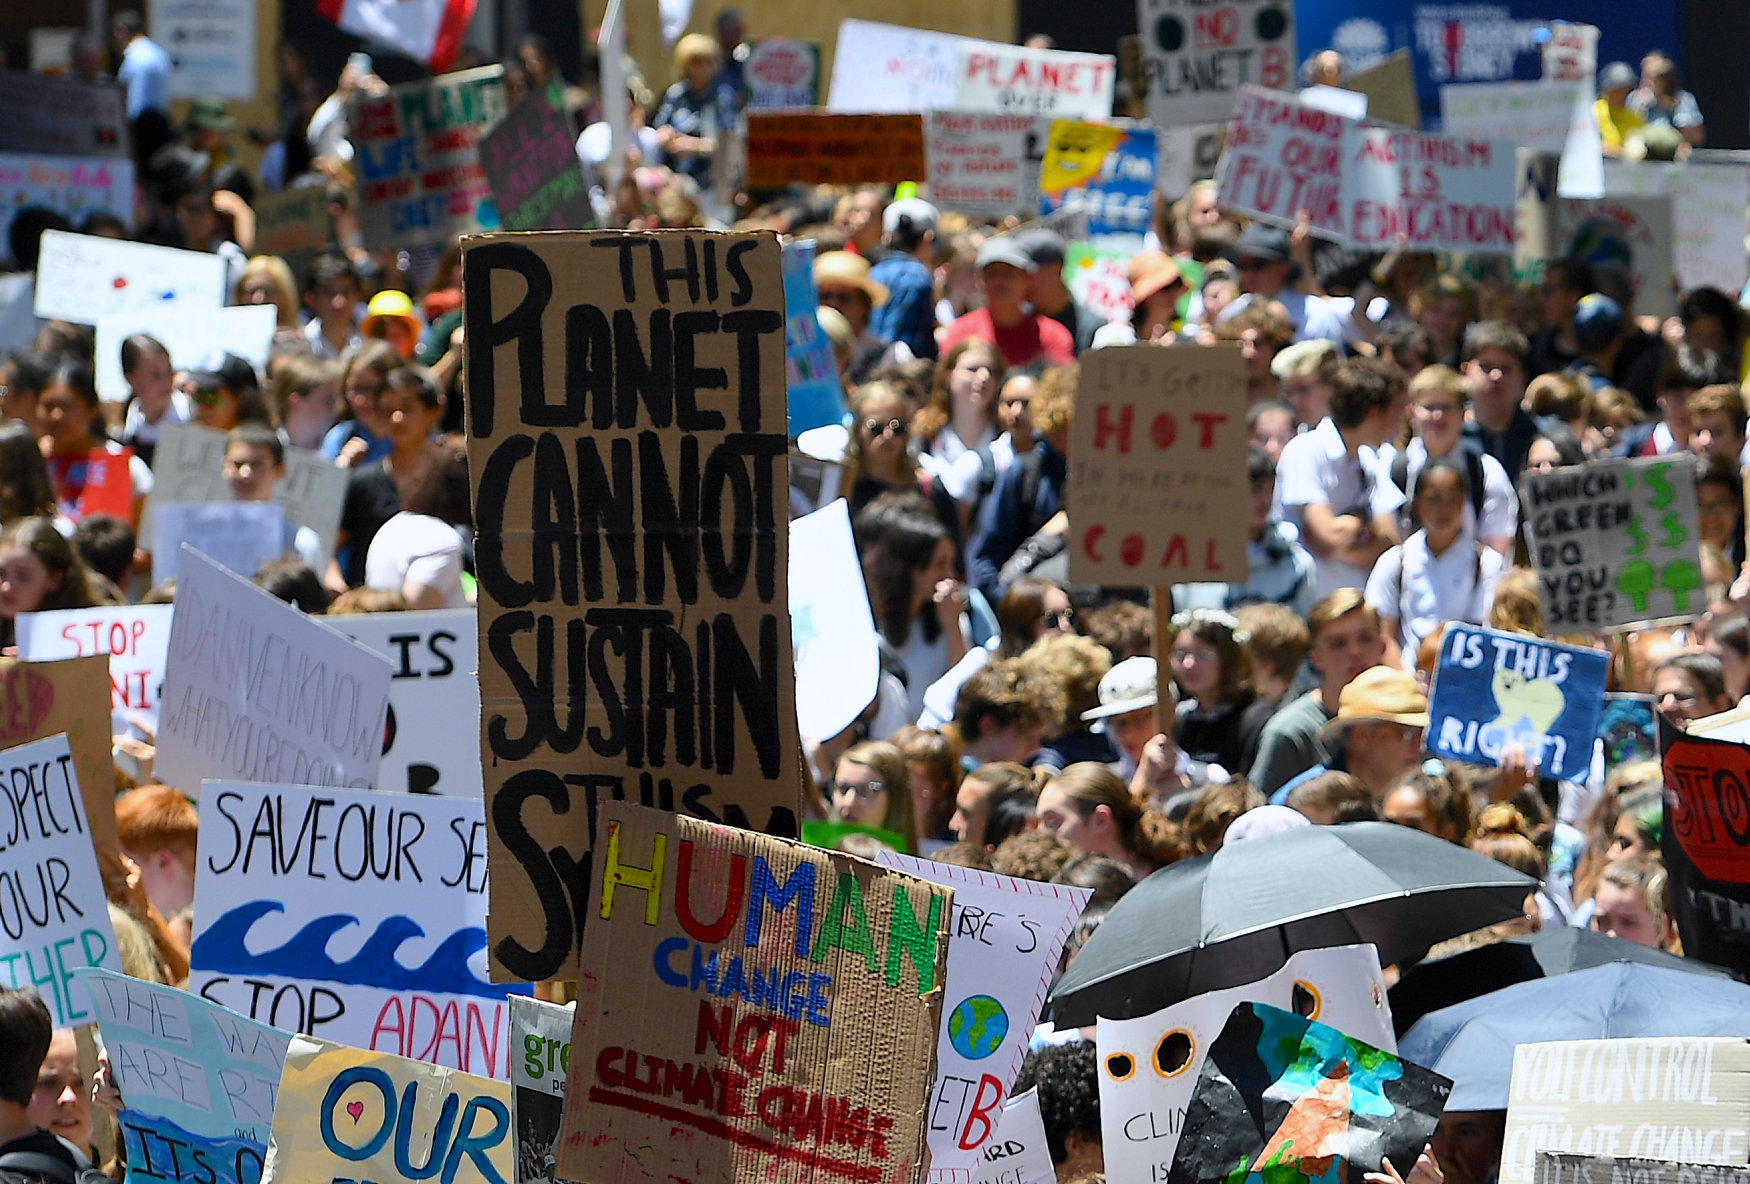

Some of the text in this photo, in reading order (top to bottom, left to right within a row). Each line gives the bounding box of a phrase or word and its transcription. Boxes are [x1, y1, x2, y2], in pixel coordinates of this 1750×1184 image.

[966, 55, 1114, 95] PLANET
[591, 237, 758, 306] THIS
[464, 242, 782, 438] PLANET
[1093, 403, 1229, 455] HOT
[1531, 471, 1618, 503] WHICH
[477, 429, 790, 607] CANNOT
[1083, 523, 1223, 573] COAL
[1534, 503, 1633, 538] GREEN
[1539, 541, 1582, 569] DO
[1543, 568, 1607, 598] YOU
[62, 619, 147, 658] STOP
[1550, 592, 1615, 626] SEE?
[1450, 630, 1573, 685] IS THIS
[489, 607, 781, 781] SUSTAIN
[208, 790, 338, 880] SAVE
[334, 802, 426, 884] OUR
[599, 819, 943, 999] HUMAN
[99, 976, 189, 1043] THE
[200, 976, 346, 1037] STOP
[653, 937, 833, 1028] CHANGE
[694, 1002, 799, 1074] NOT
[119, 1045, 211, 1113] ARE
[596, 1046, 748, 1119] CLIMATE
[756, 1084, 895, 1160] CHANGE
[1514, 1041, 1719, 1106] YOU CONTROL
[234, 1127, 258, 1143] and
[1630, 1122, 1747, 1165] CHANGE
